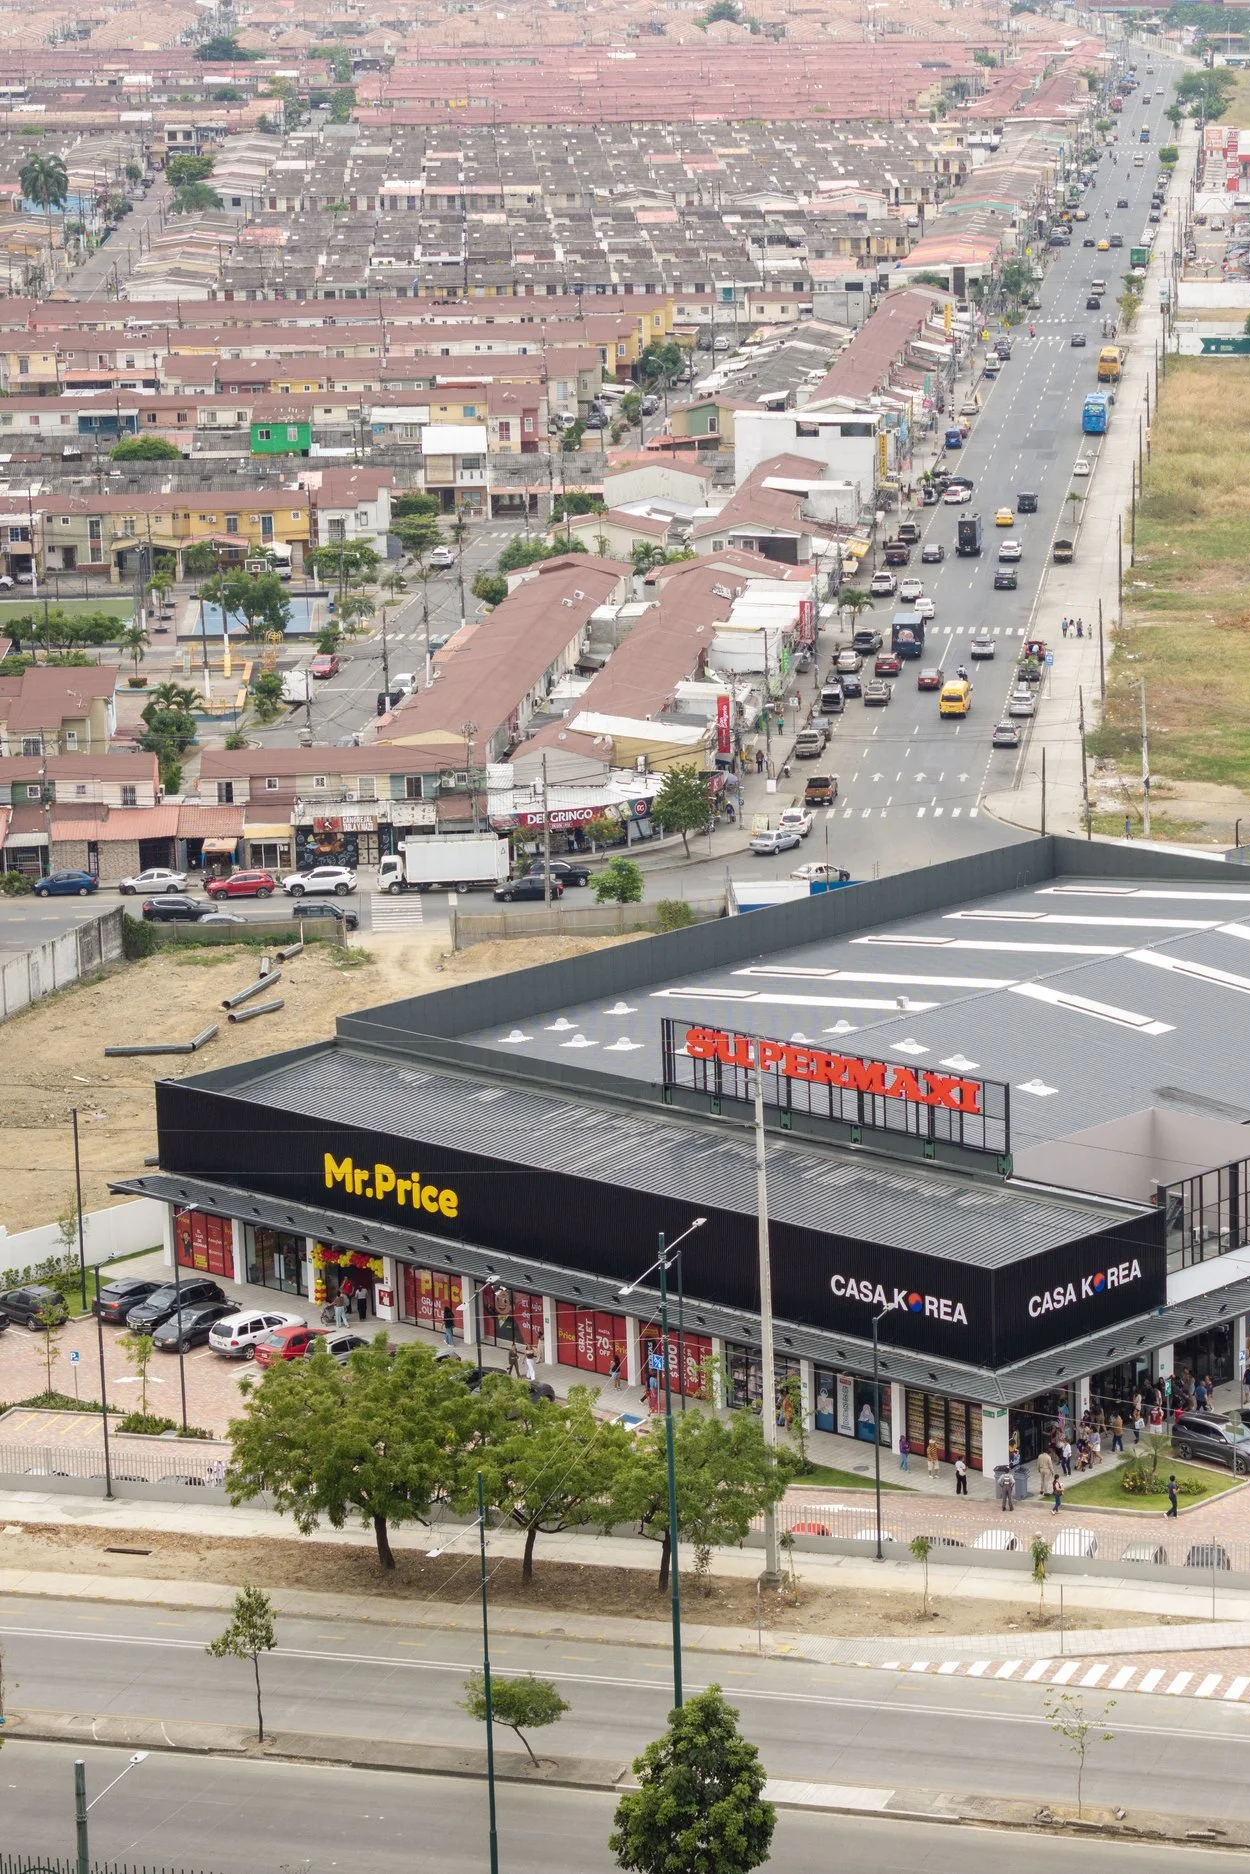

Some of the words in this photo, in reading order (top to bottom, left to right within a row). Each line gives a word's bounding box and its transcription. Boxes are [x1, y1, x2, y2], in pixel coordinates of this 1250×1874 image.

[550, 809, 593, 823] GRINGO
[686, 1027, 981, 1114] SUPERMAXI
[324, 1152, 459, 1218] Mr.Price
[421, 1296, 441, 1309] GRAN
[830, 1274, 887, 1307] CASA
[893, 1288, 968, 1325] KOREA
[1028, 1283, 1077, 1318] CASA
[1081, 1259, 1142, 1298] KOREA
[422, 1307, 445, 1319] OUTLE
[577, 1322, 586, 1353] GRAN
[585, 1317, 594, 1362] OUTLET
[599, 1349, 611, 1357] OFF
[668, 1344, 679, 1378] $100
